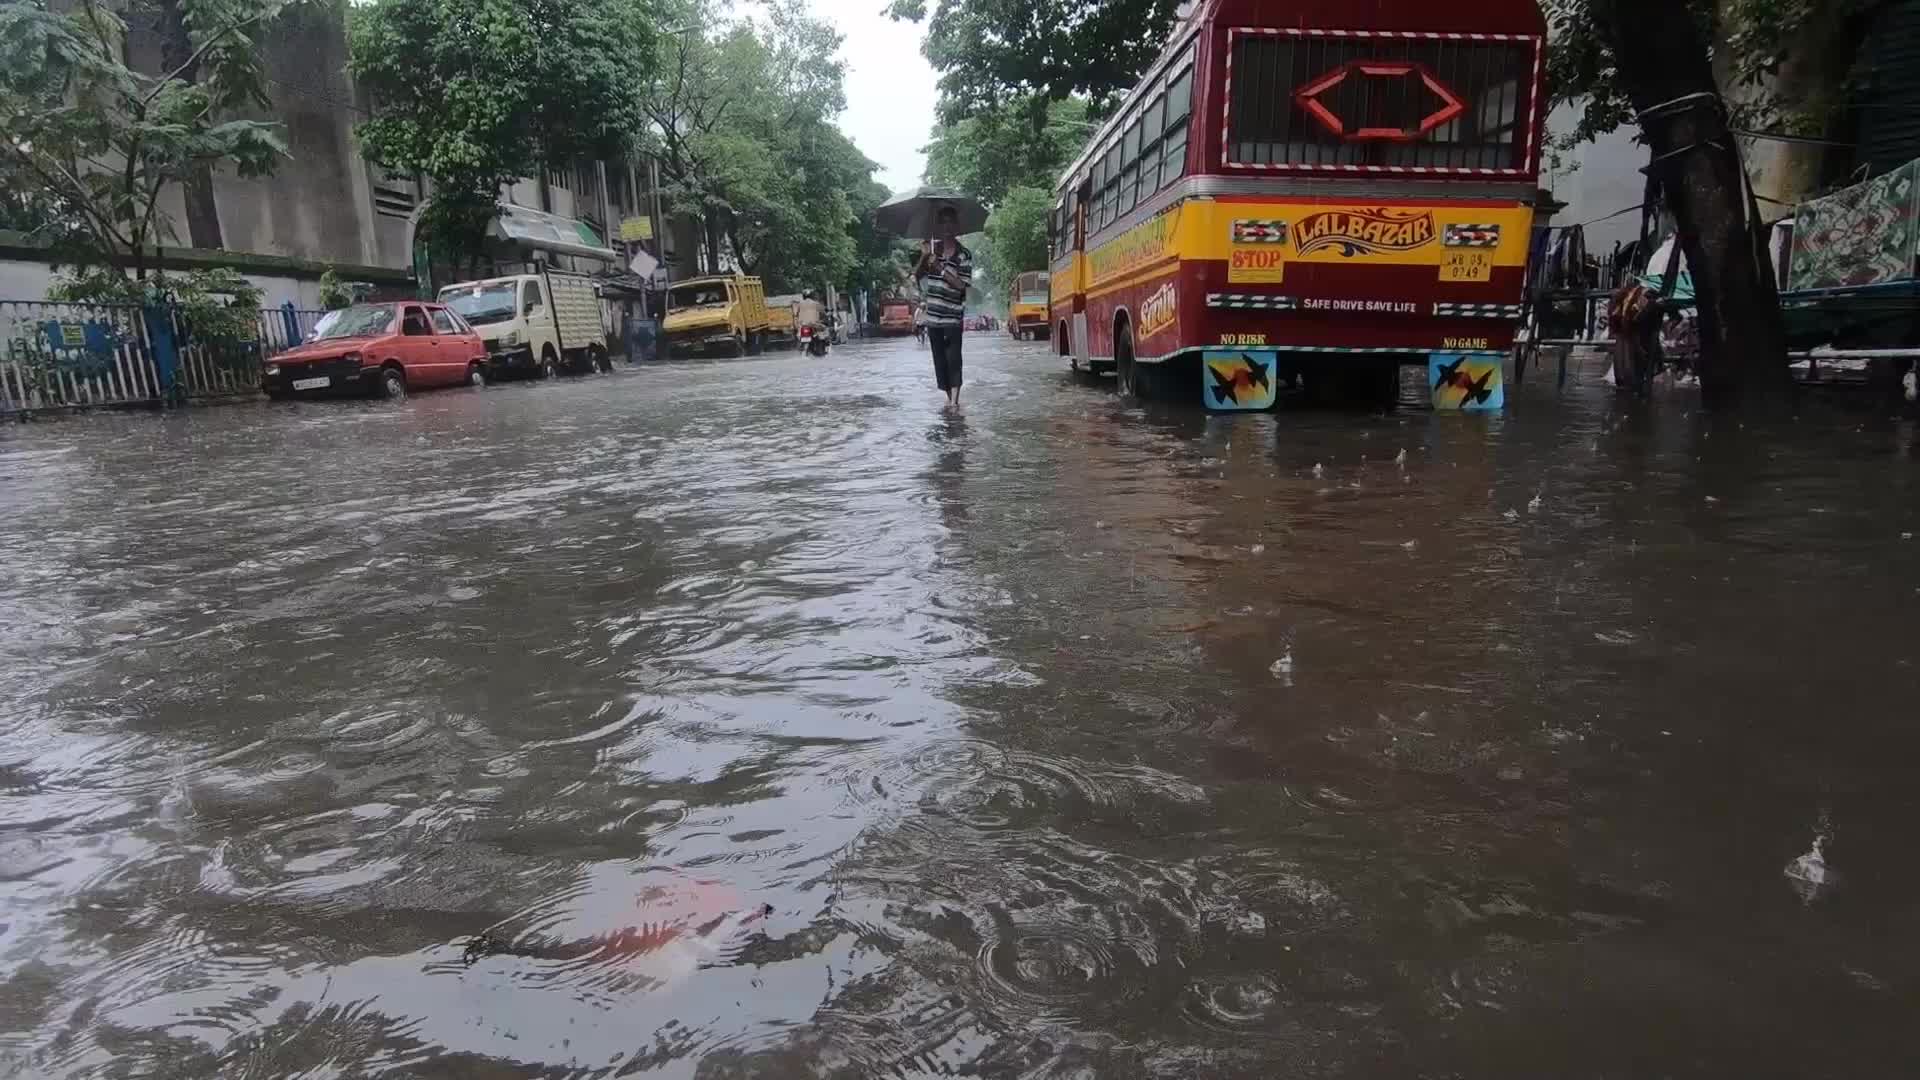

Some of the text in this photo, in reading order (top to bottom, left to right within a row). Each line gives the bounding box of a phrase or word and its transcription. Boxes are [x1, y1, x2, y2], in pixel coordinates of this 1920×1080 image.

[1298, 212, 1430, 246] LALBAZAR
[1232, 250, 1281, 268] STOP
[1303, 298, 1417, 313] SAFE DRIVE SAVE LIFE
[1220, 334, 1266, 345] NO RISK
[1443, 337, 1488, 349] NO GAME
